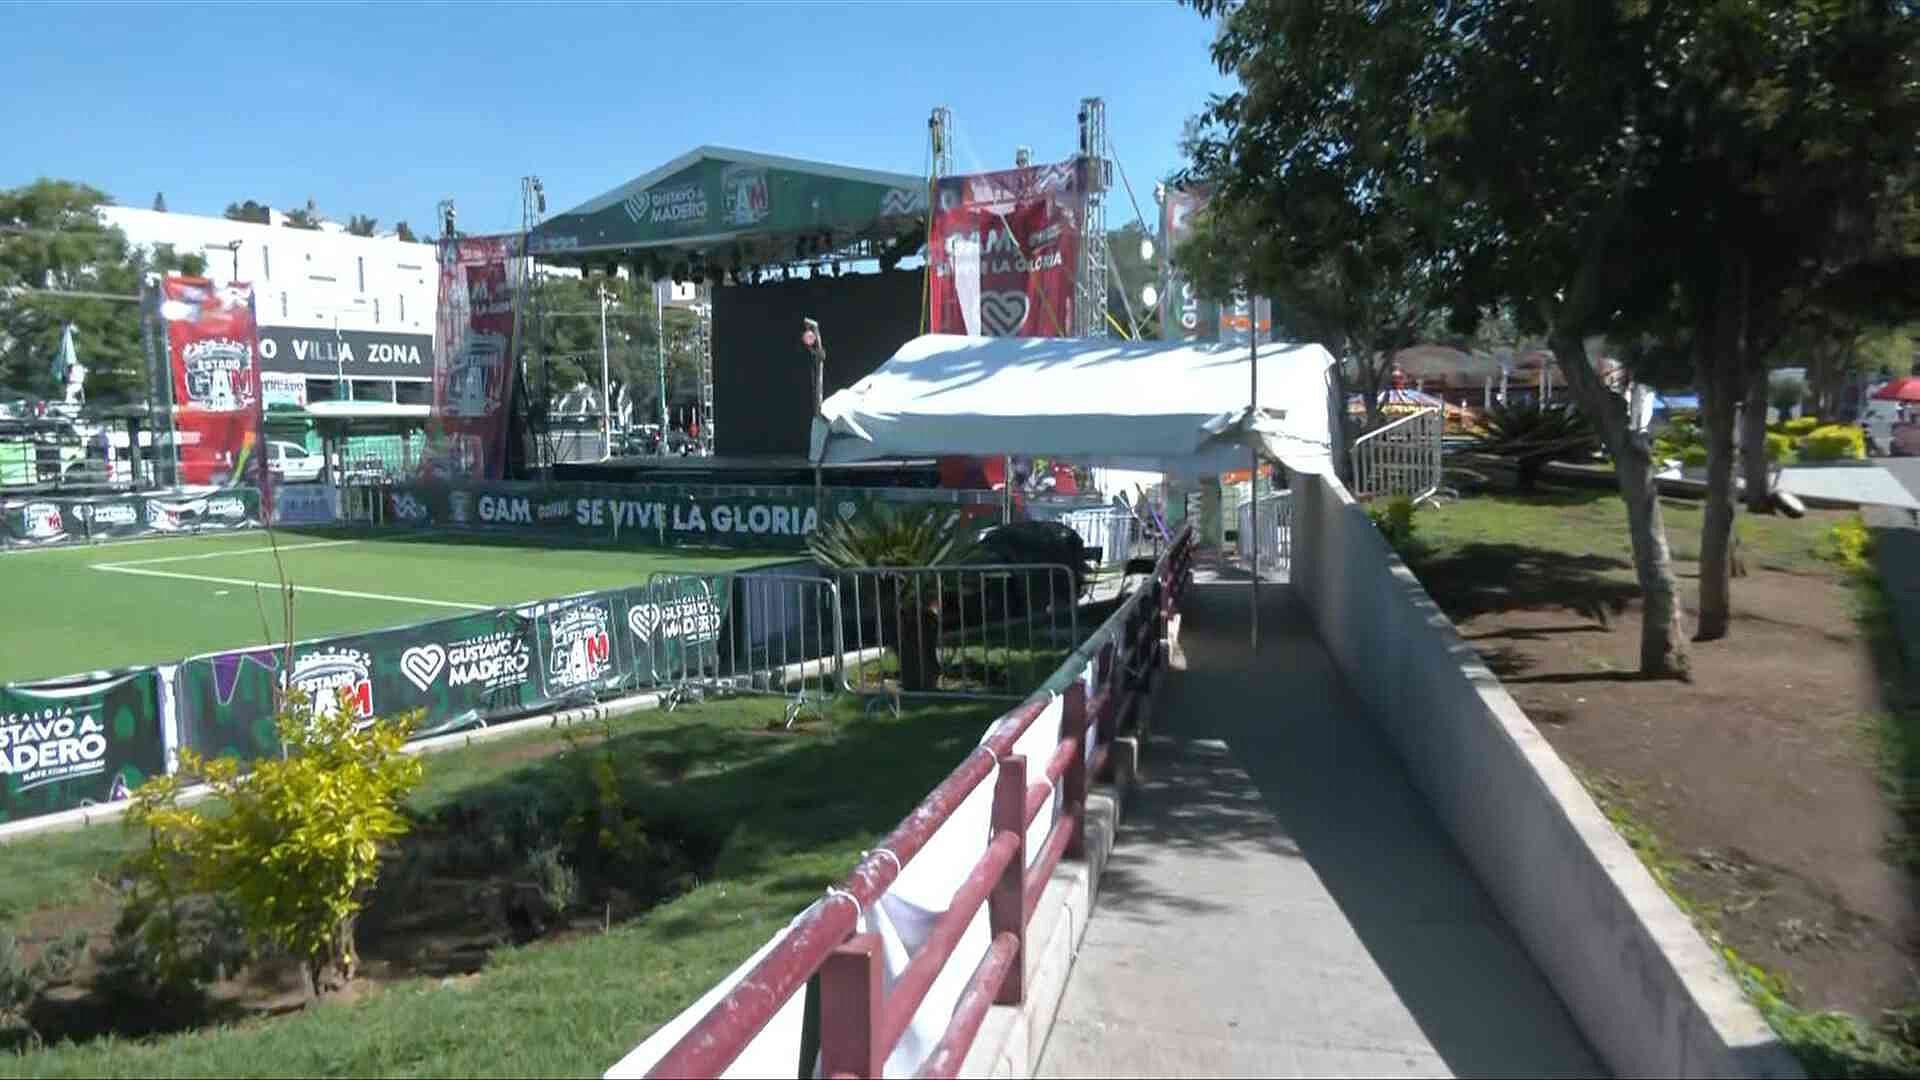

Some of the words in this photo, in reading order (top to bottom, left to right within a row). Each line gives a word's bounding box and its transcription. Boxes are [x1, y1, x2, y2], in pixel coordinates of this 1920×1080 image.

[292, 339, 354, 361] VILLA
[367, 343, 421, 364] ZONA
[478, 496, 532, 522] GAM
[576, 498, 604, 526] SE
[607, 499, 666, 529] VIVE
[673, 504, 706, 532] LA
[711, 504, 818, 535] GLORIA
[447, 640, 502, 665] GUSTAVO
[448, 653, 530, 687] MADERO
